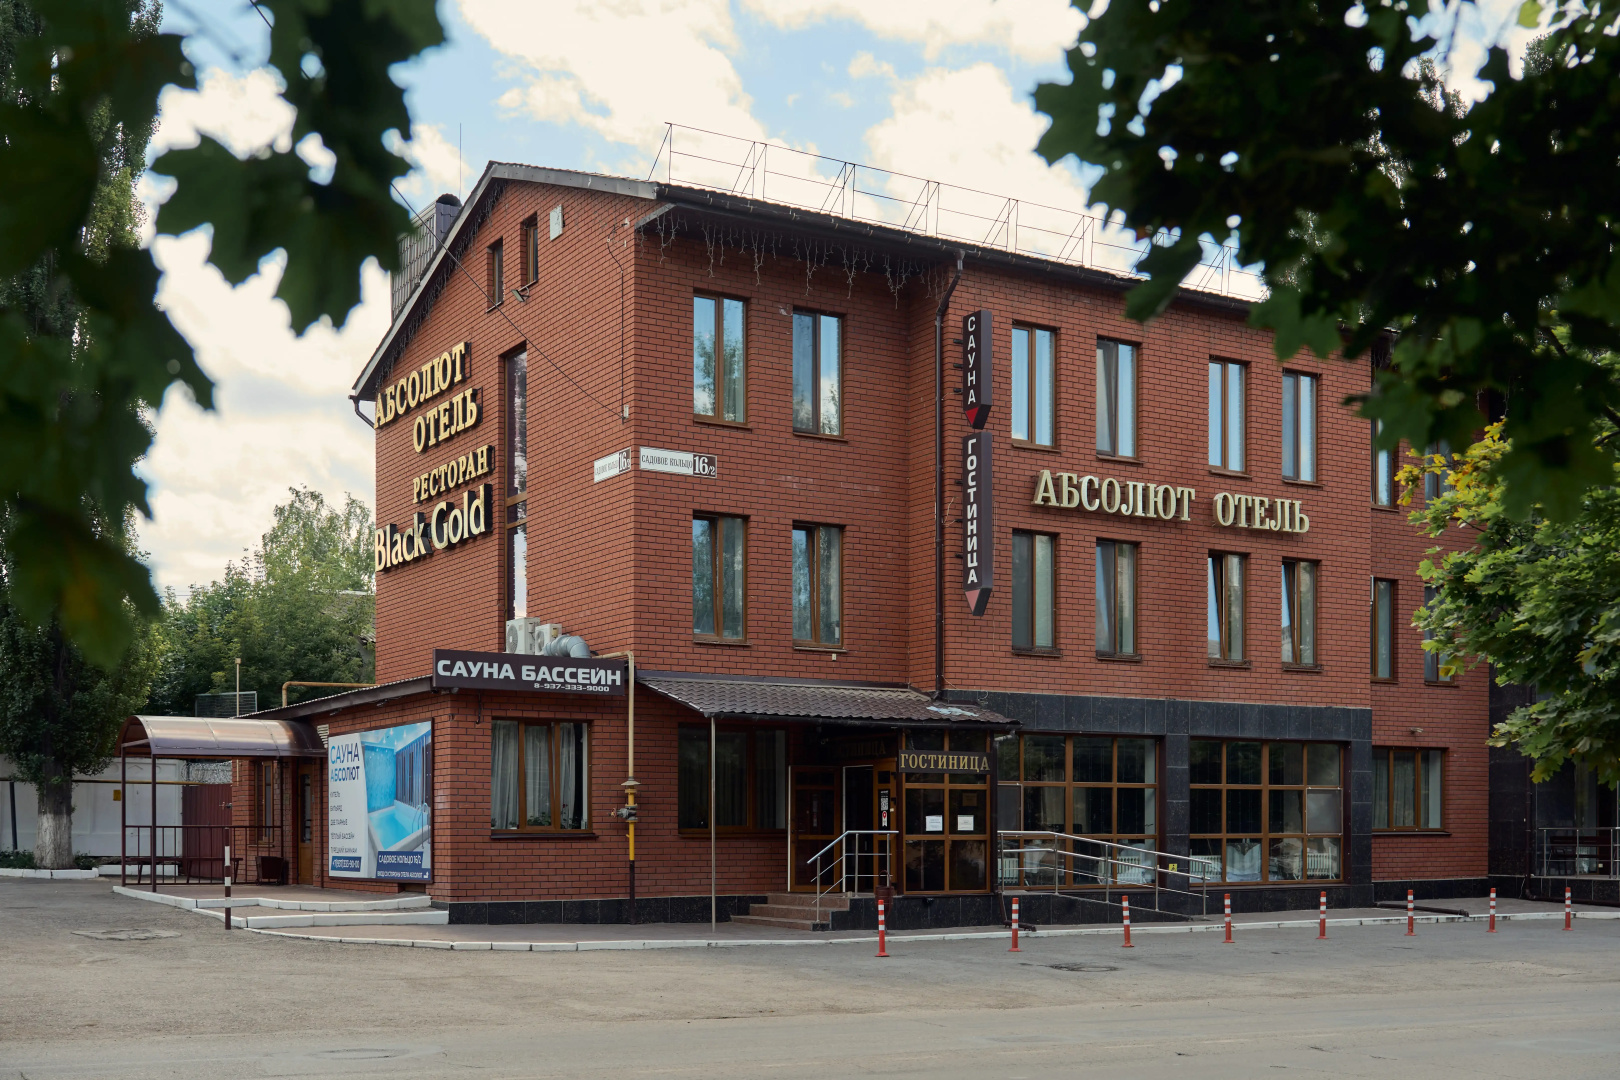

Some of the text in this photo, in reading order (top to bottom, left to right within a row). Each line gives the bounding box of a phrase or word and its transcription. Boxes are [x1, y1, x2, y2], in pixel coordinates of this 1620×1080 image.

[373, 341, 466, 430] АБСОЛЮТ
[967, 316, 976, 405] САУНА
[412, 387, 478, 453] ОТЕЛЬ
[412, 444, 490, 504] РЕСТОРАН
[641, 454, 716, 476] САДОВОЕ КОЛЬЦО 16/2
[374, 484, 486, 572] Black Gold
[966, 438, 979, 584] ГОСТИНИЦА
[1033, 469, 1310, 534] АБСОЛЮТ ОТЕЛЬ
[437, 659, 621, 686] САУНА БАССЕЙН
[533, 682, 610, 692] 8-937-333-9000
[330, 742, 360, 765] САУНА
[330, 765, 360, 782] АБСОЛЮТ
[900, 753, 991, 773] ГОСТИНИЦА
